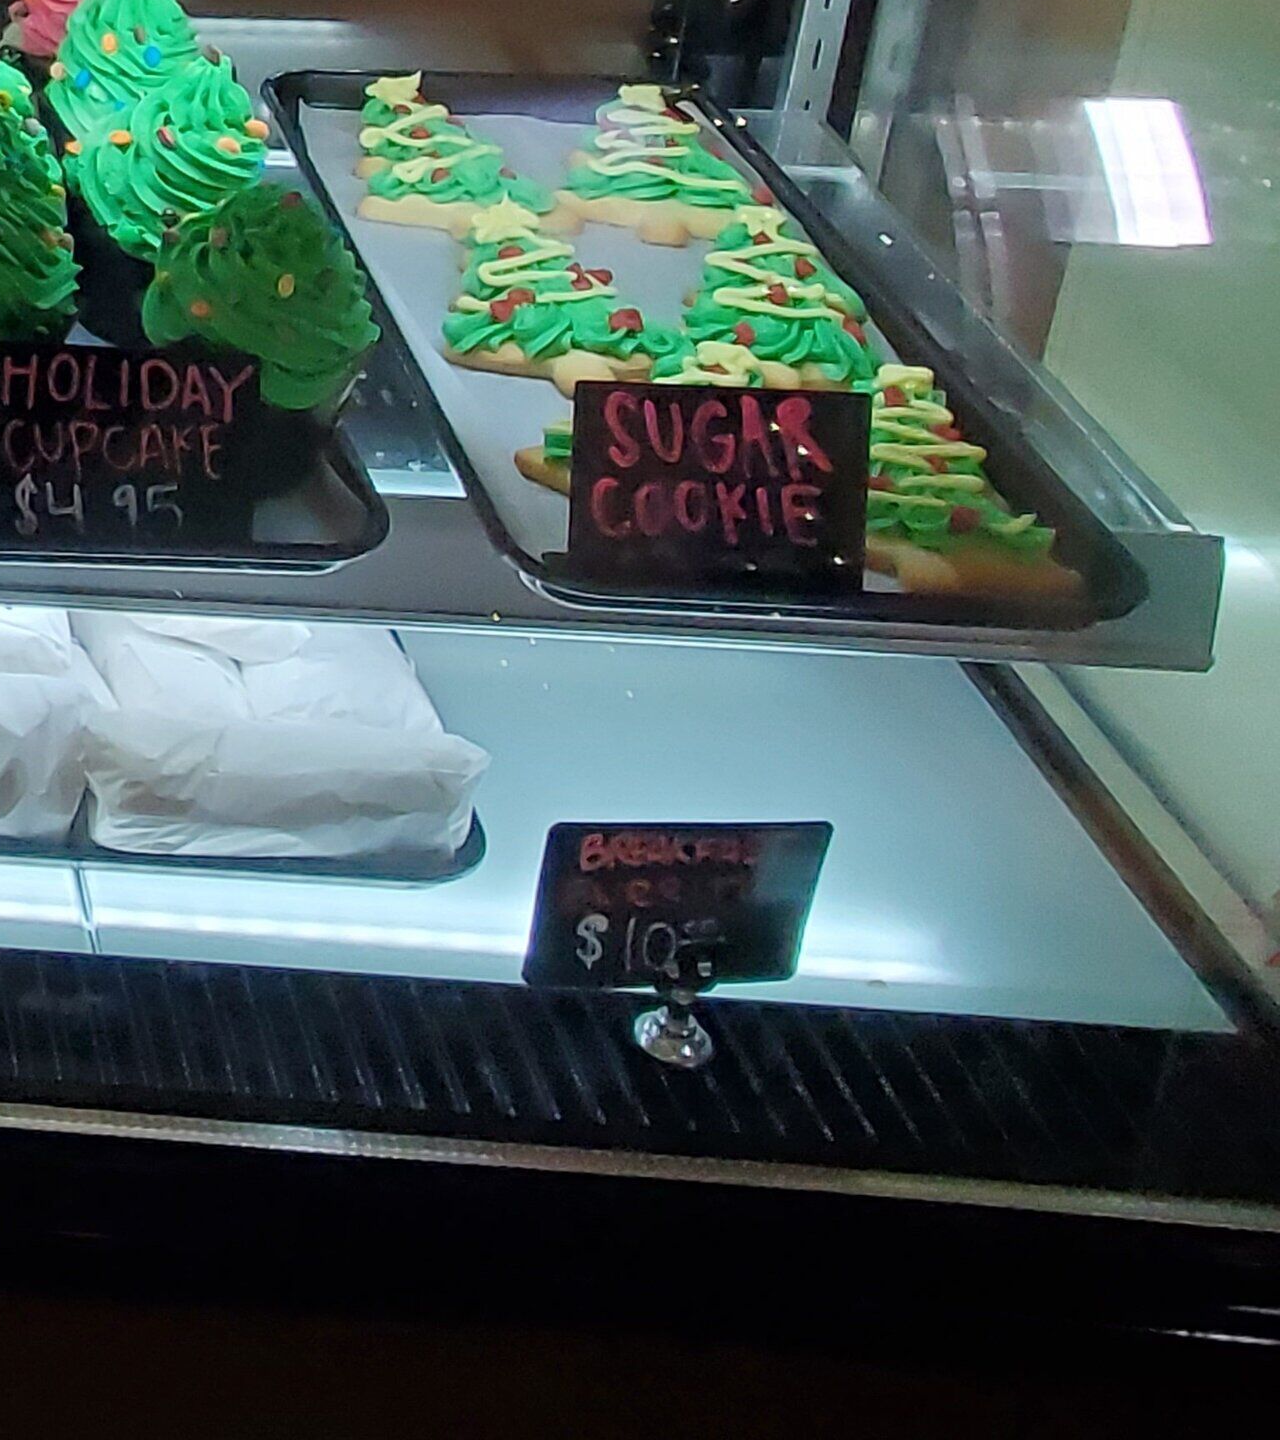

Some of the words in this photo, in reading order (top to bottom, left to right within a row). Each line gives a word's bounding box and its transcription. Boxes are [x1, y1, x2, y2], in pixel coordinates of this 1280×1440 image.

[0, 351, 255, 424] HOLIDAY
[2, 417, 224, 482] CUPCAKE
[603, 390, 834, 482] SUGAR
[590, 476, 824, 548] COOKIE
